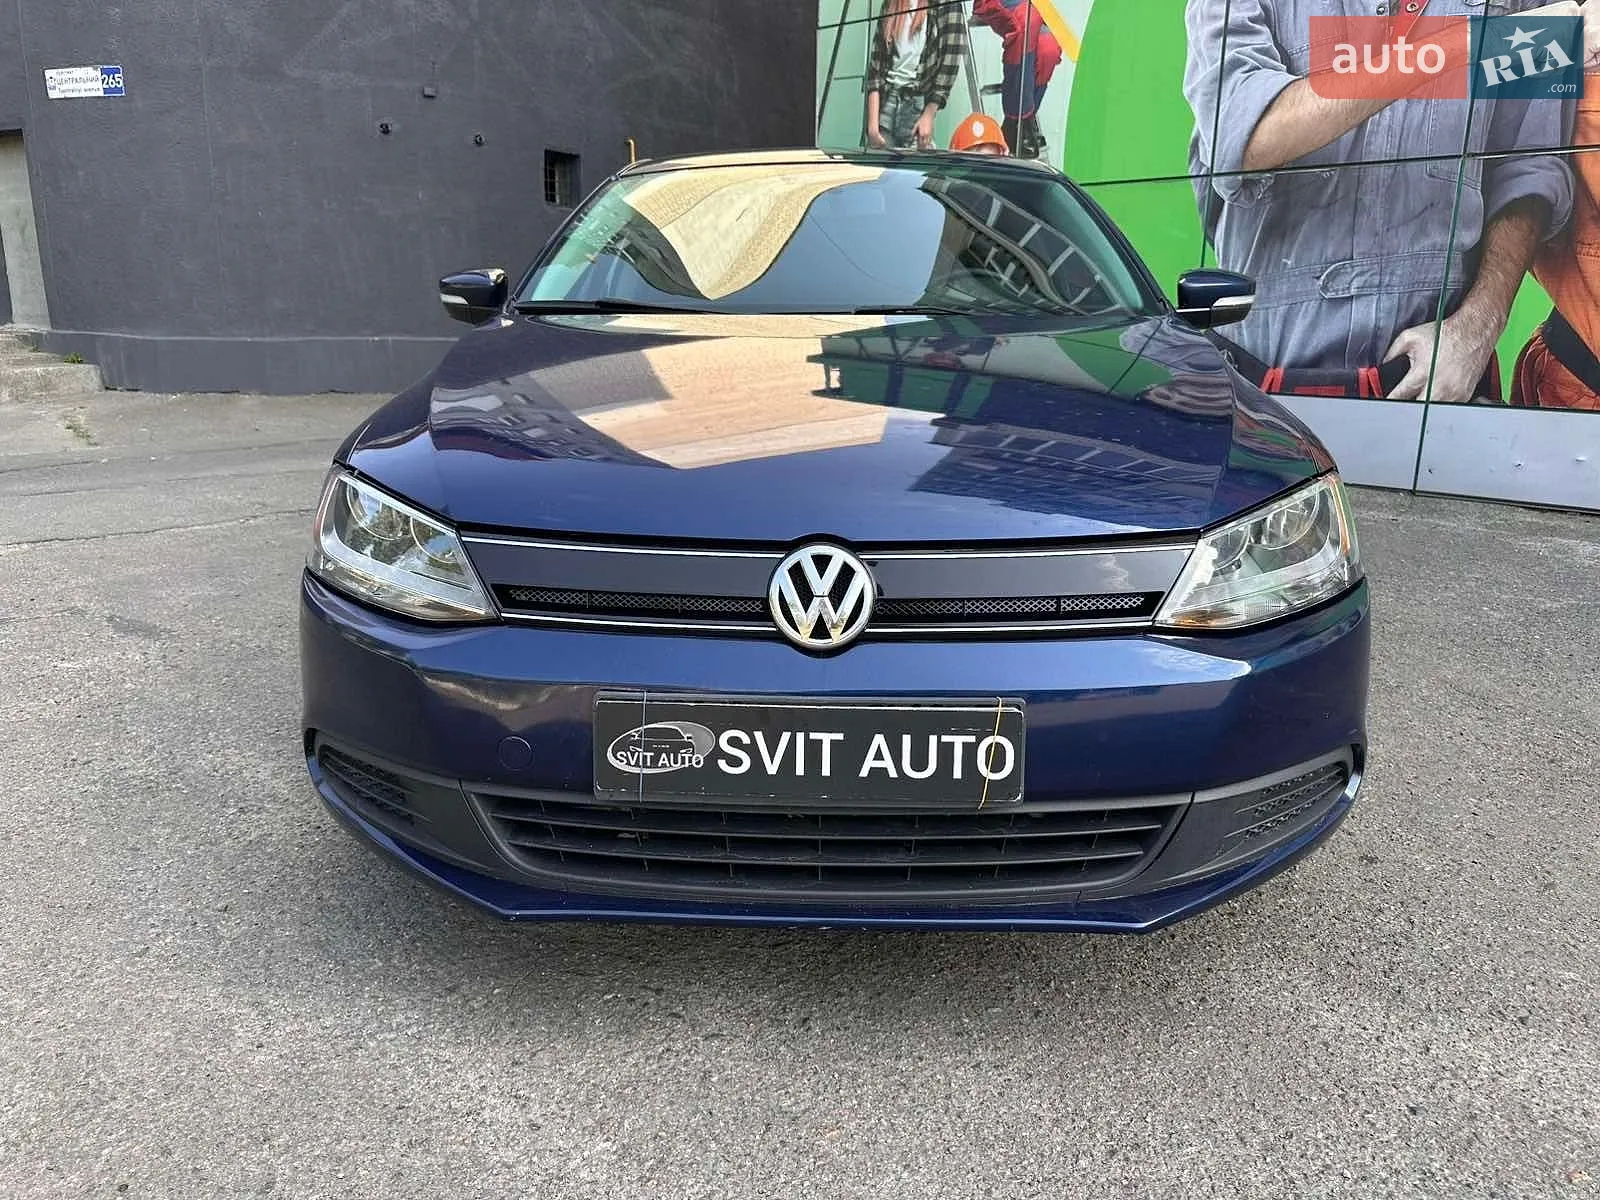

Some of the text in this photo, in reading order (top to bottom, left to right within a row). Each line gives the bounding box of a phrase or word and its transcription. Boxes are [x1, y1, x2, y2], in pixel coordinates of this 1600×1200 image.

[102, 73, 123, 88] 265
[616, 751, 704, 768] SVIT AUTO
[717, 729, 1015, 781] SVIT AUTO
